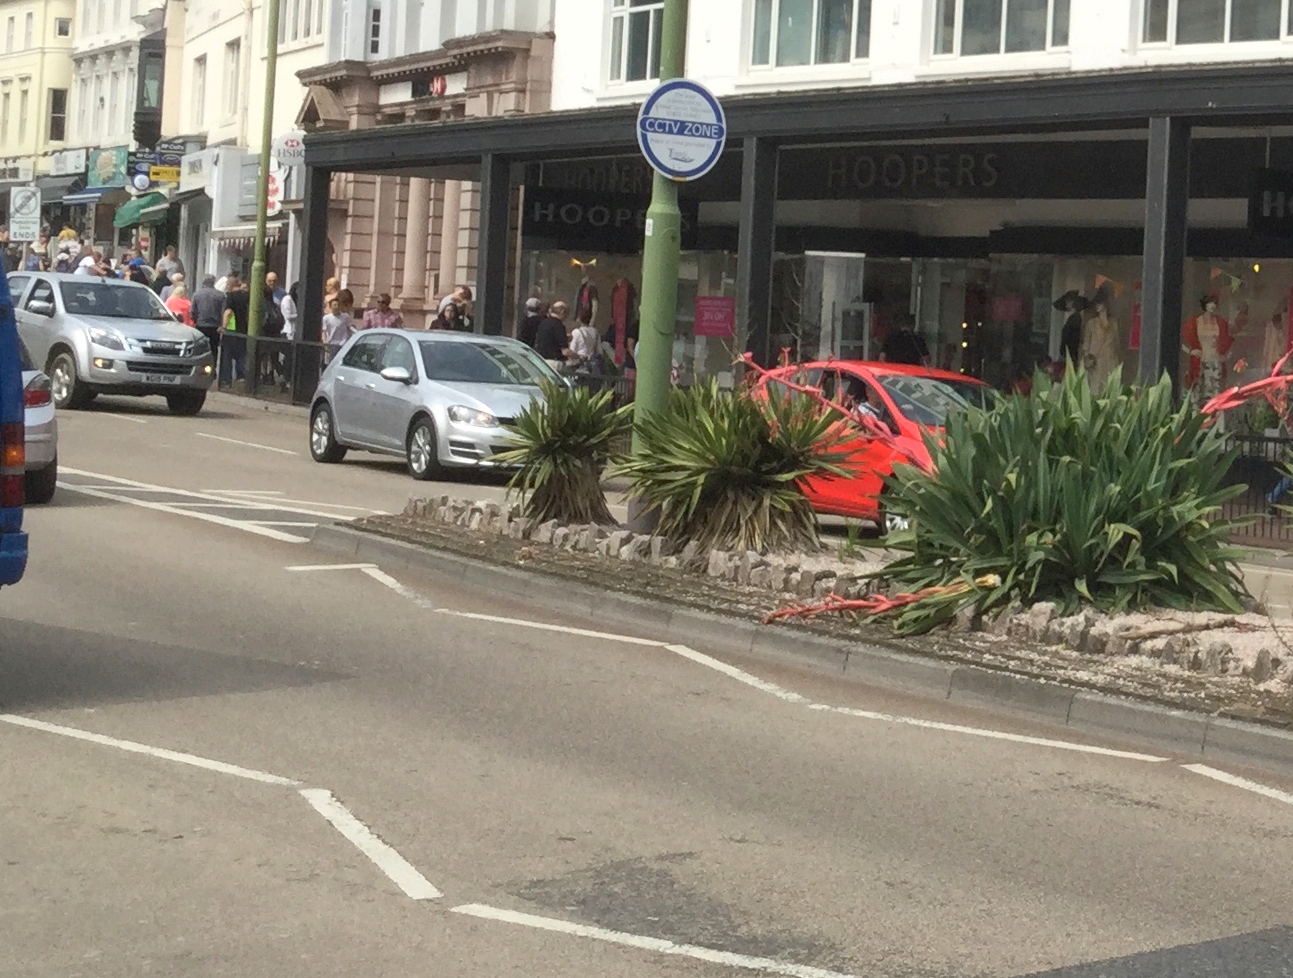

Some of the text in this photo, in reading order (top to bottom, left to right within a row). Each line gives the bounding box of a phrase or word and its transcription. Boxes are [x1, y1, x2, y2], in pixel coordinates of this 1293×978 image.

[646, 118, 719, 138] CCTV ZONE
[827, 153, 998, 189] HOOPERS
[13, 231, 36, 239] ENDS
